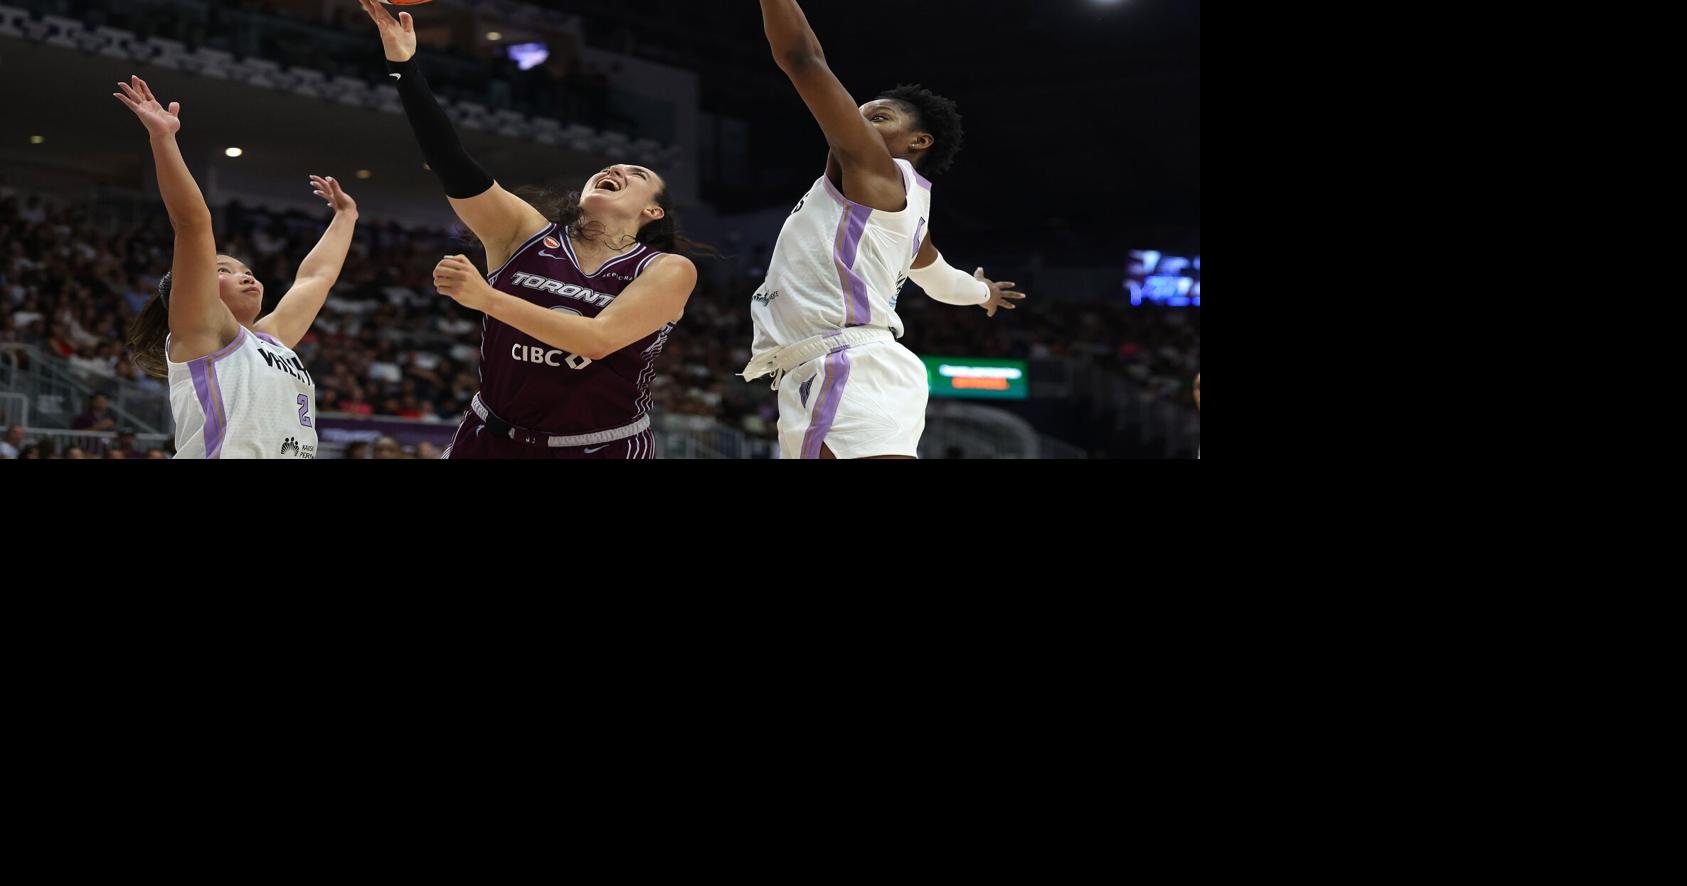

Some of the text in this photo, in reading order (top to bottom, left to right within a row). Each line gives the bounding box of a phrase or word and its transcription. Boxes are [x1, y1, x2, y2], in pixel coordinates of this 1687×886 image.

[511, 270, 616, 307] TORONT
[511, 343, 563, 367] CIBC
[296, 393, 313, 428] 2
